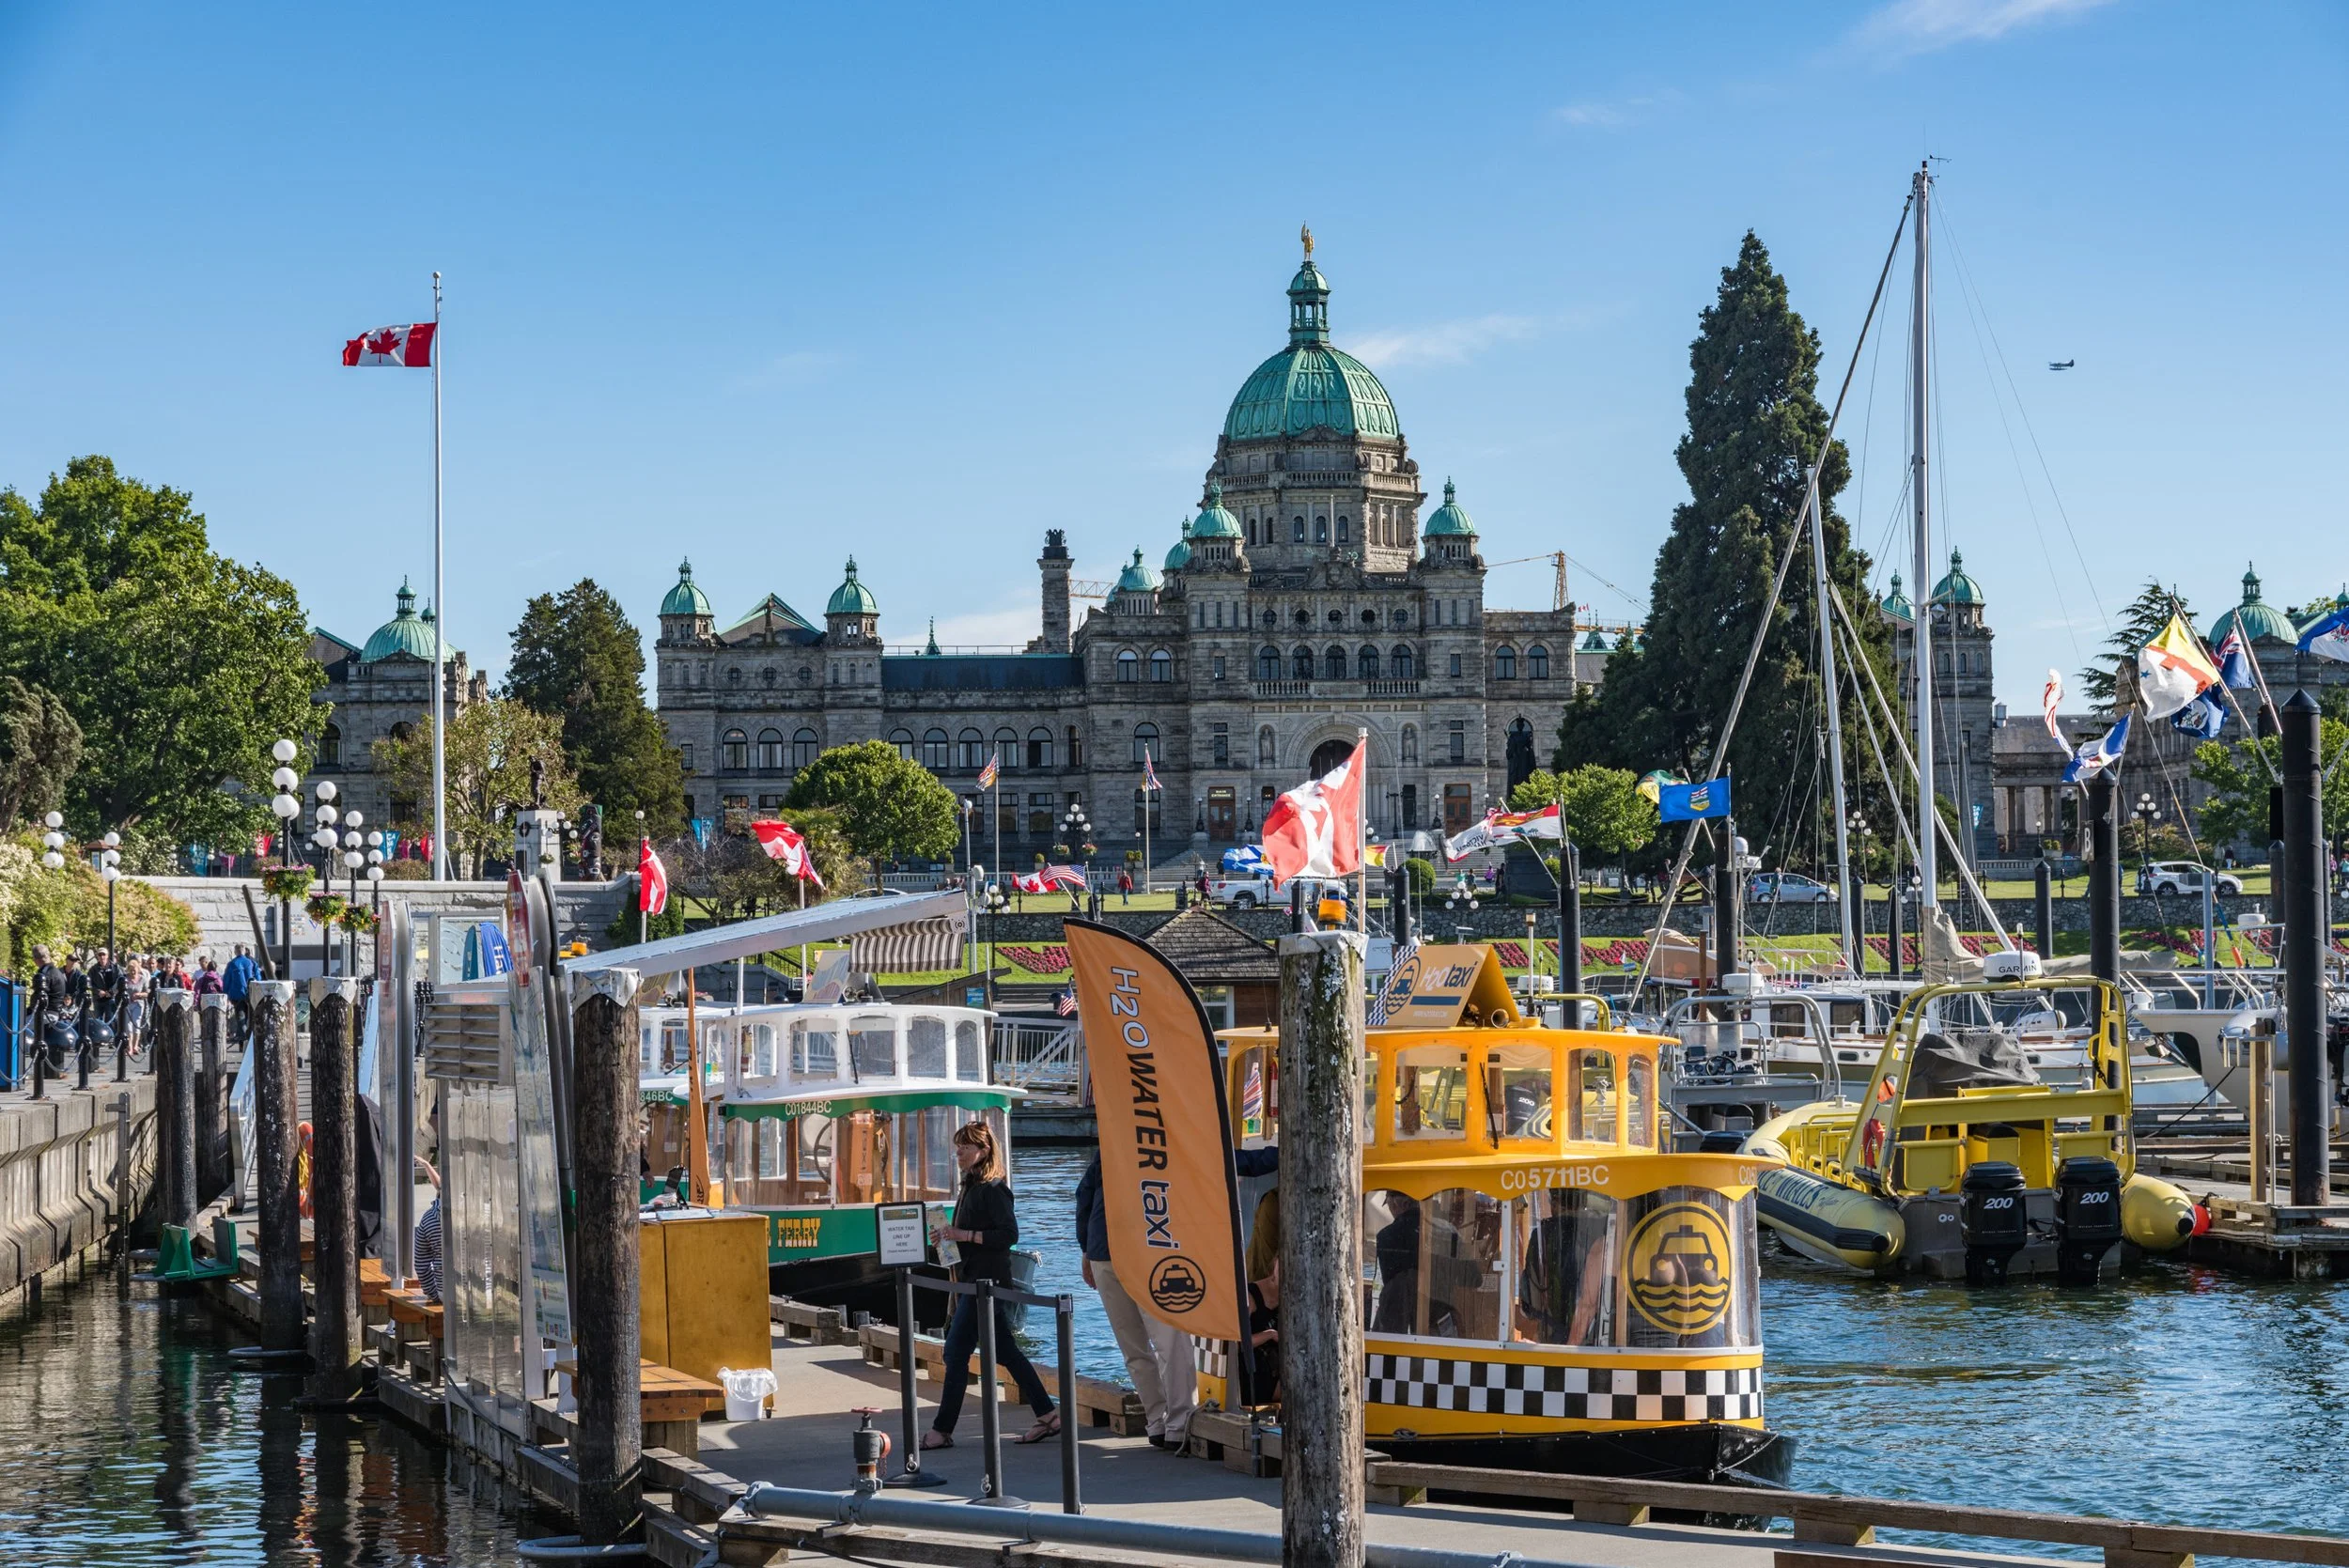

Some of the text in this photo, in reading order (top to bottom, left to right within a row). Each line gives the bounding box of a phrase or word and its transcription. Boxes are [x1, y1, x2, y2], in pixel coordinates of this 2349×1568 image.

[2084, 827, 2092, 853] B
[640, 1090, 674, 1102] 846BC
[1518, 1096, 1535, 1107] 200
[1983, 1197, 2014, 1210] 200
[2079, 1191, 2109, 1204] 200
[1141, 1180, 1181, 1249] taxi
[777, 1218, 821, 1248] FERRY
